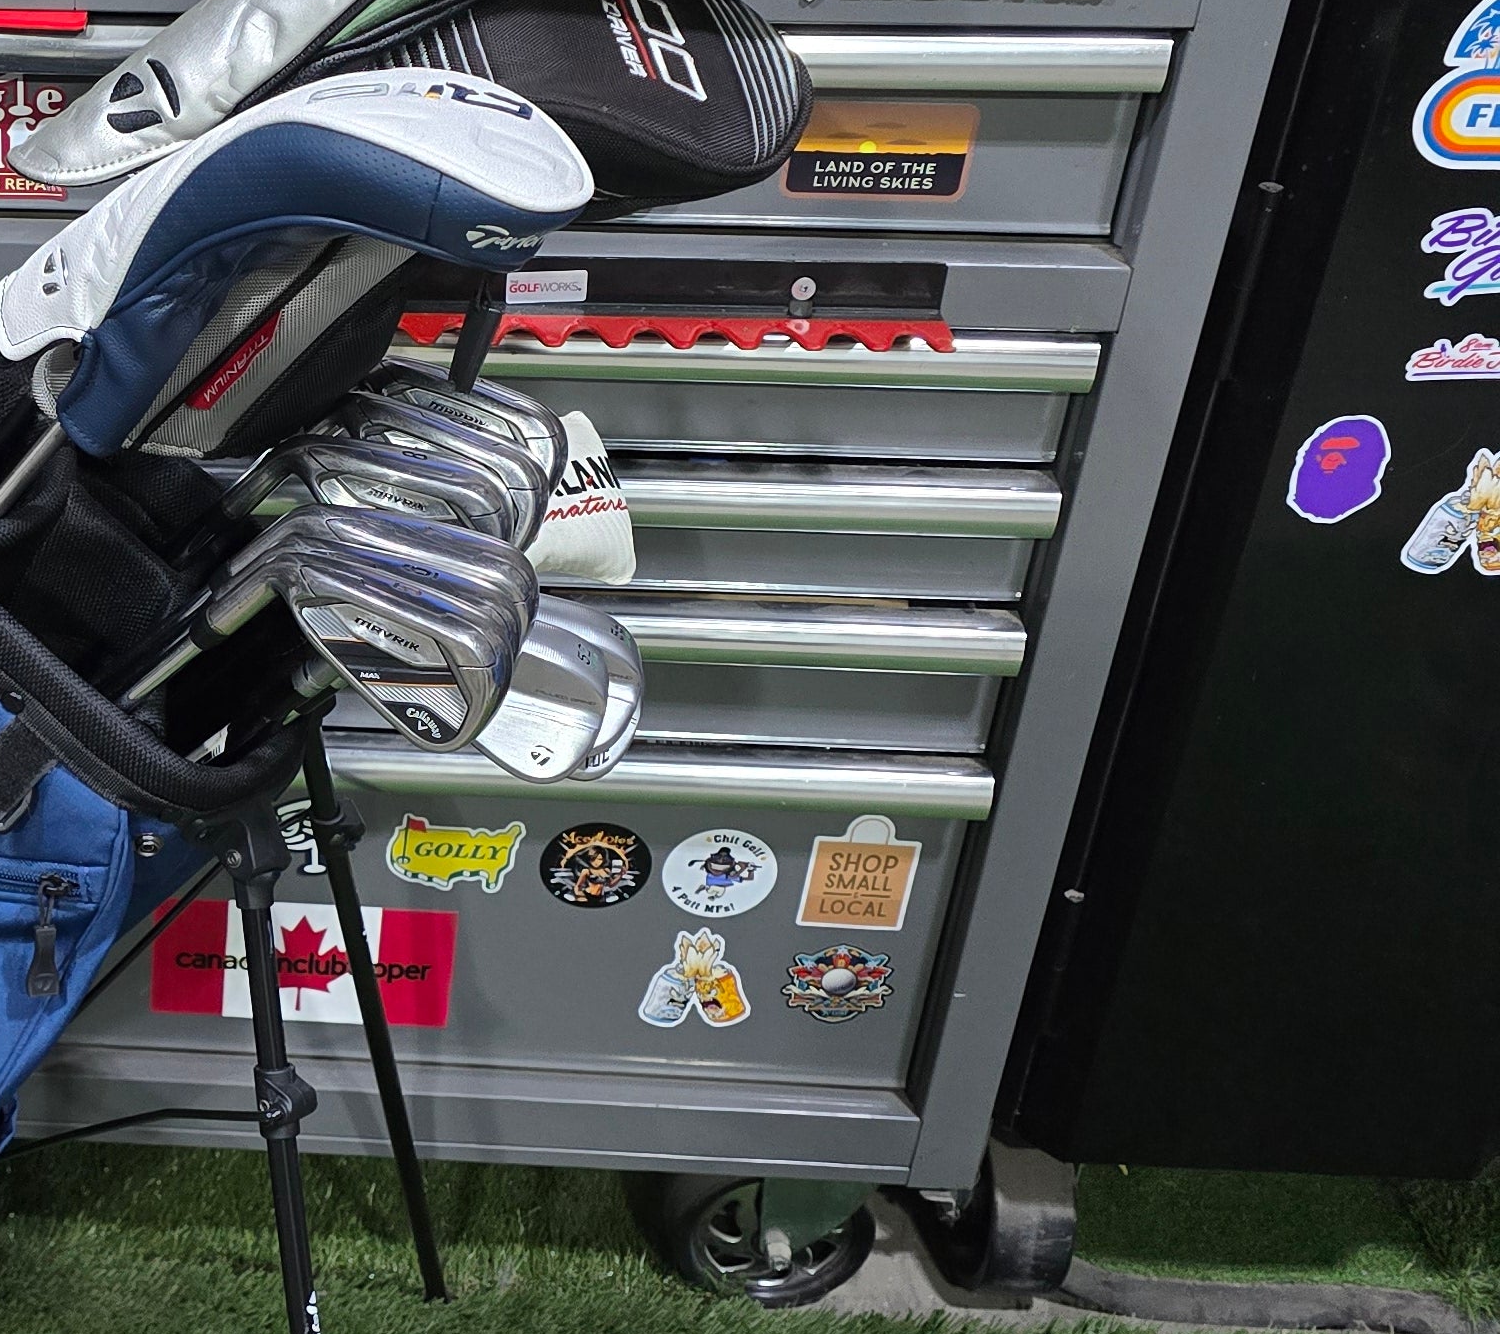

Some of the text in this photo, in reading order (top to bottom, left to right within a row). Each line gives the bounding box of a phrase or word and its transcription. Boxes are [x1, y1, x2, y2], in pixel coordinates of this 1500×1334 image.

[601, 0, 648, 78] DRIVER
[814, 161, 937, 176] LAND OF THE
[5, 178, 62, 192] REPA
[812, 176, 934, 190] LIVING SKIES
[508, 280, 582, 295] GOLFWORKS
[202, 333, 270, 403] TITANIUM
[1412, 350, 1485, 370] Birdie
[543, 496, 628, 523] nature
[354, 616, 421, 653] MAVRIK
[405, 707, 442, 739] Callaway
[414, 841, 509, 861] GOLLY
[713, 833, 765, 860] Chit Golf
[828, 851, 899, 875] SHOP
[824, 873, 893, 893] SMALL
[678, 888, 702, 911] Putt
[819, 898, 887, 918] LOCAL
[175, 949, 431, 983] canadnclubopper
